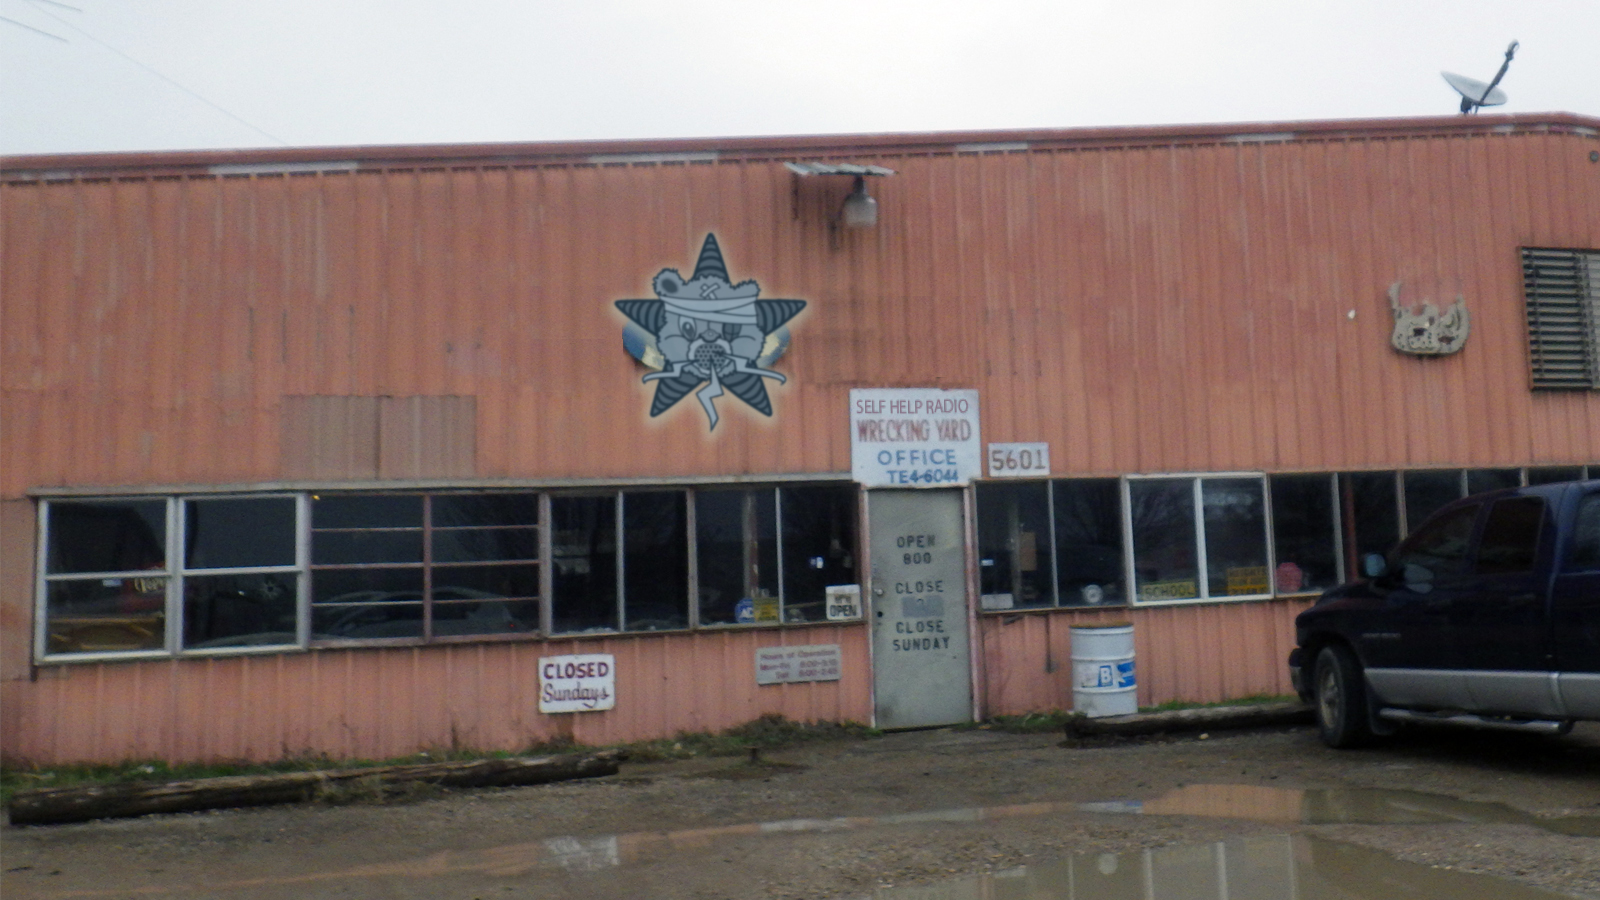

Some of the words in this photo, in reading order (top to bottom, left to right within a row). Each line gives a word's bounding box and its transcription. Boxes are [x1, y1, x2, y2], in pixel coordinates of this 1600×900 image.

[856, 400, 886, 414] SELF
[889, 400, 923, 414] HELP
[926, 399, 969, 414] RADIO
[857, 419, 930, 442] WRECKING
[936, 418, 971, 441] YARD
[877, 449, 957, 465] OFFICE
[992, 449, 1046, 470] 5601
[897, 535, 936, 548] OPEN
[903, 552, 932, 565] 800
[895, 580, 944, 594] CLOSE
[1145, 583, 1195, 597] SCHOOL
[829, 605, 857, 617] OPEN
[895, 620, 945, 634] CLOSE
[893, 636, 950, 651] SUNDAY
[543, 662, 609, 679] CLOSED
[542, 681, 609, 708] Sundays
